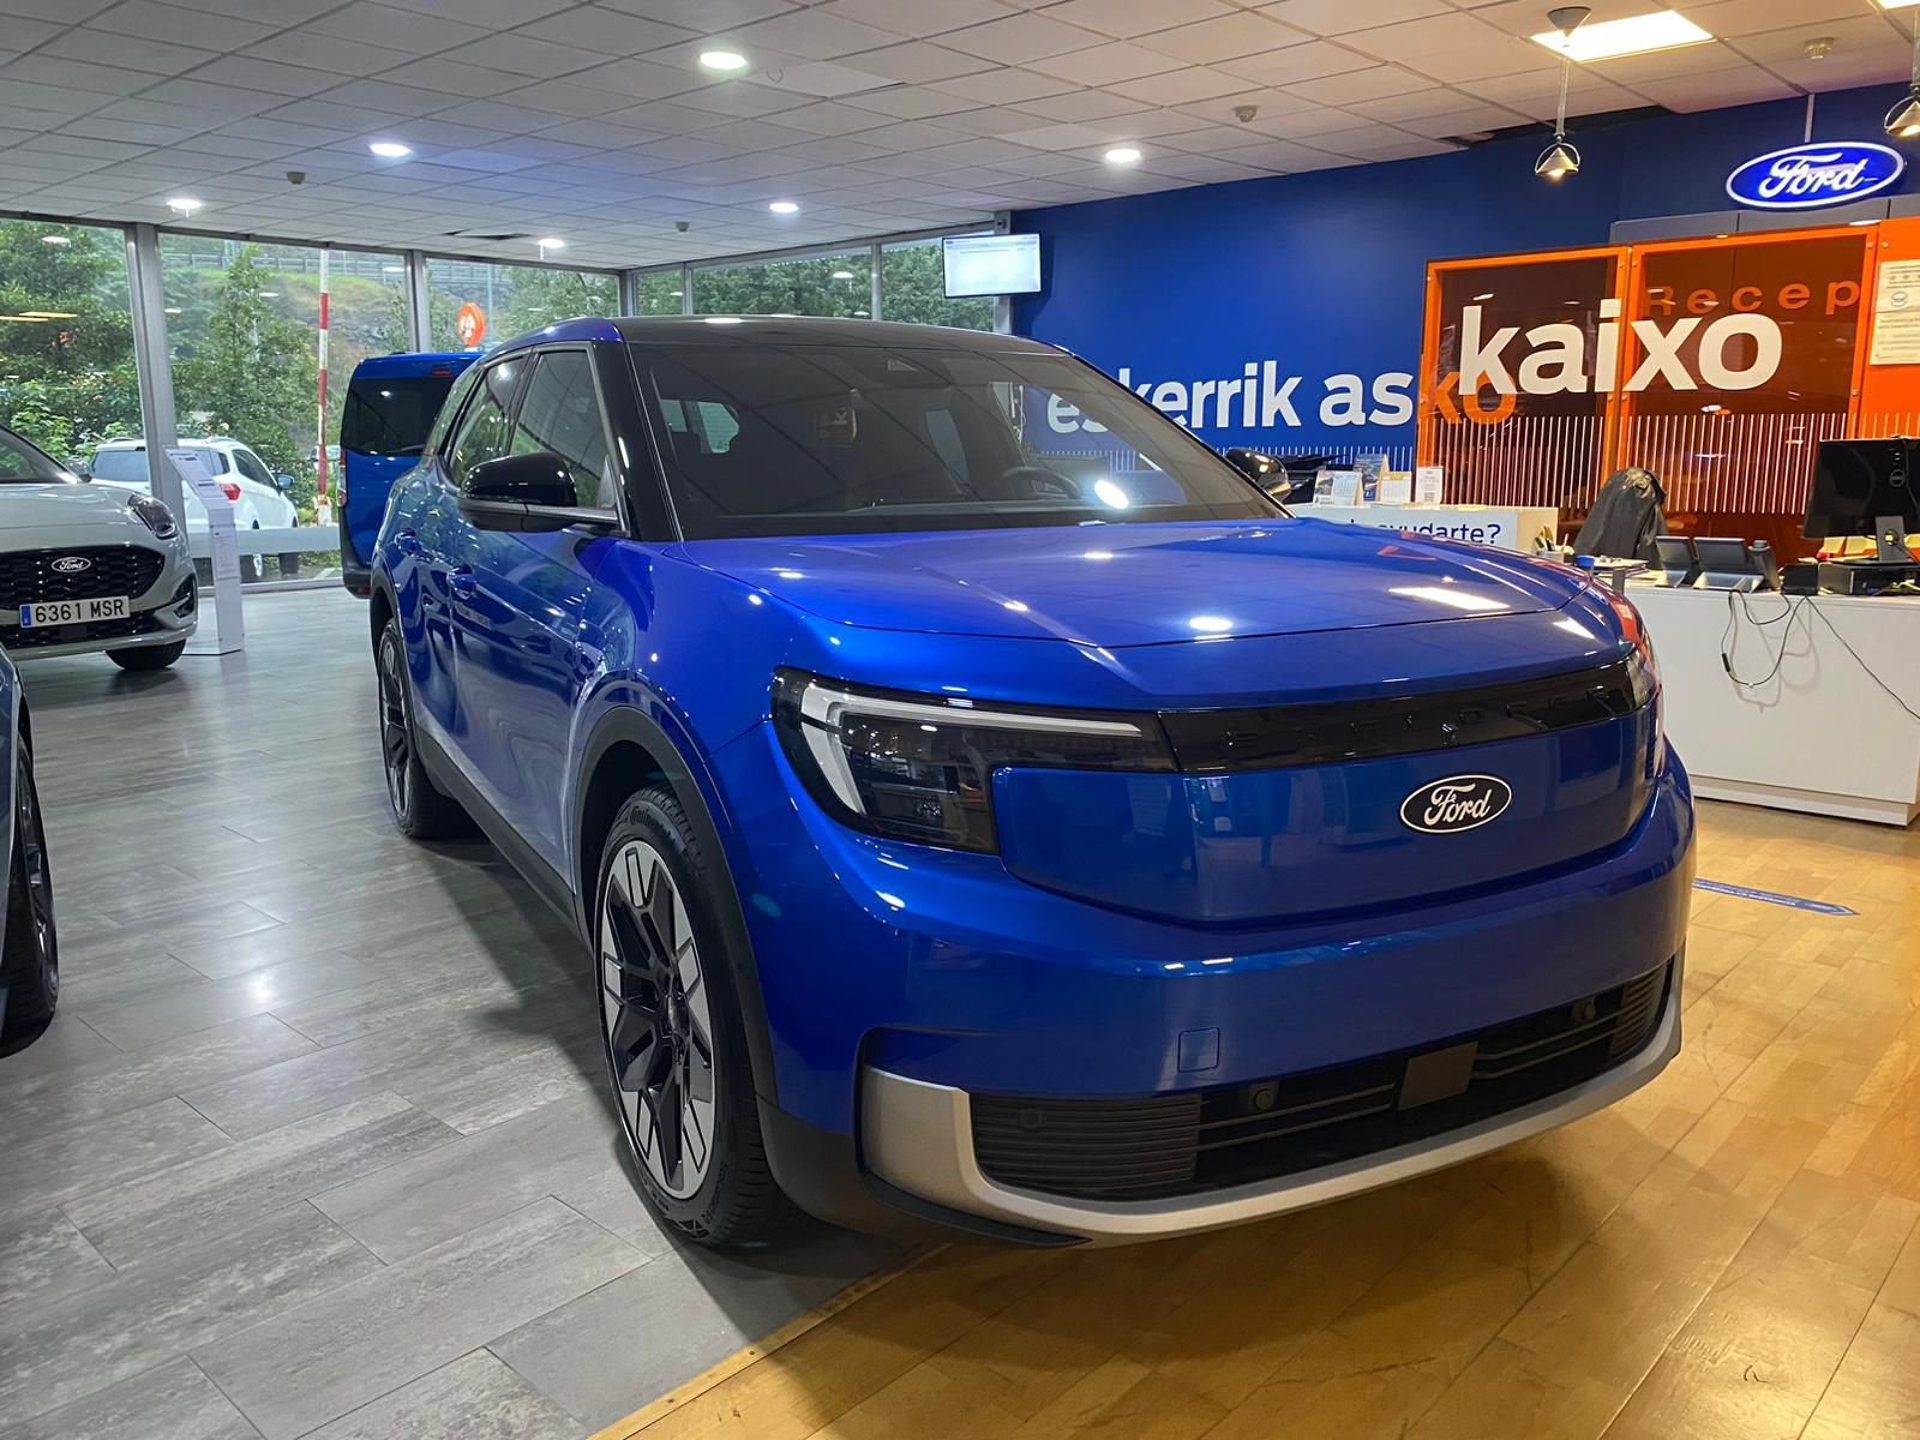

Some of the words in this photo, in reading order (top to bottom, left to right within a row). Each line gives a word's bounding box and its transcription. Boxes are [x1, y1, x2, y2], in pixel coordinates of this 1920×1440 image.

[1758, 152, 1876, 198] Ford
[1643, 279, 1860, 317] Recep
[1458, 298, 1783, 396] kaixo
[1047, 360, 1302, 434] eerrik
[1379, 522, 1502, 544] darte?
[59, 559, 84, 570] Ford
[35, 603, 82, 623] 6361
[91, 600, 125, 619] MSR
[1423, 783, 1493, 826] Ford
